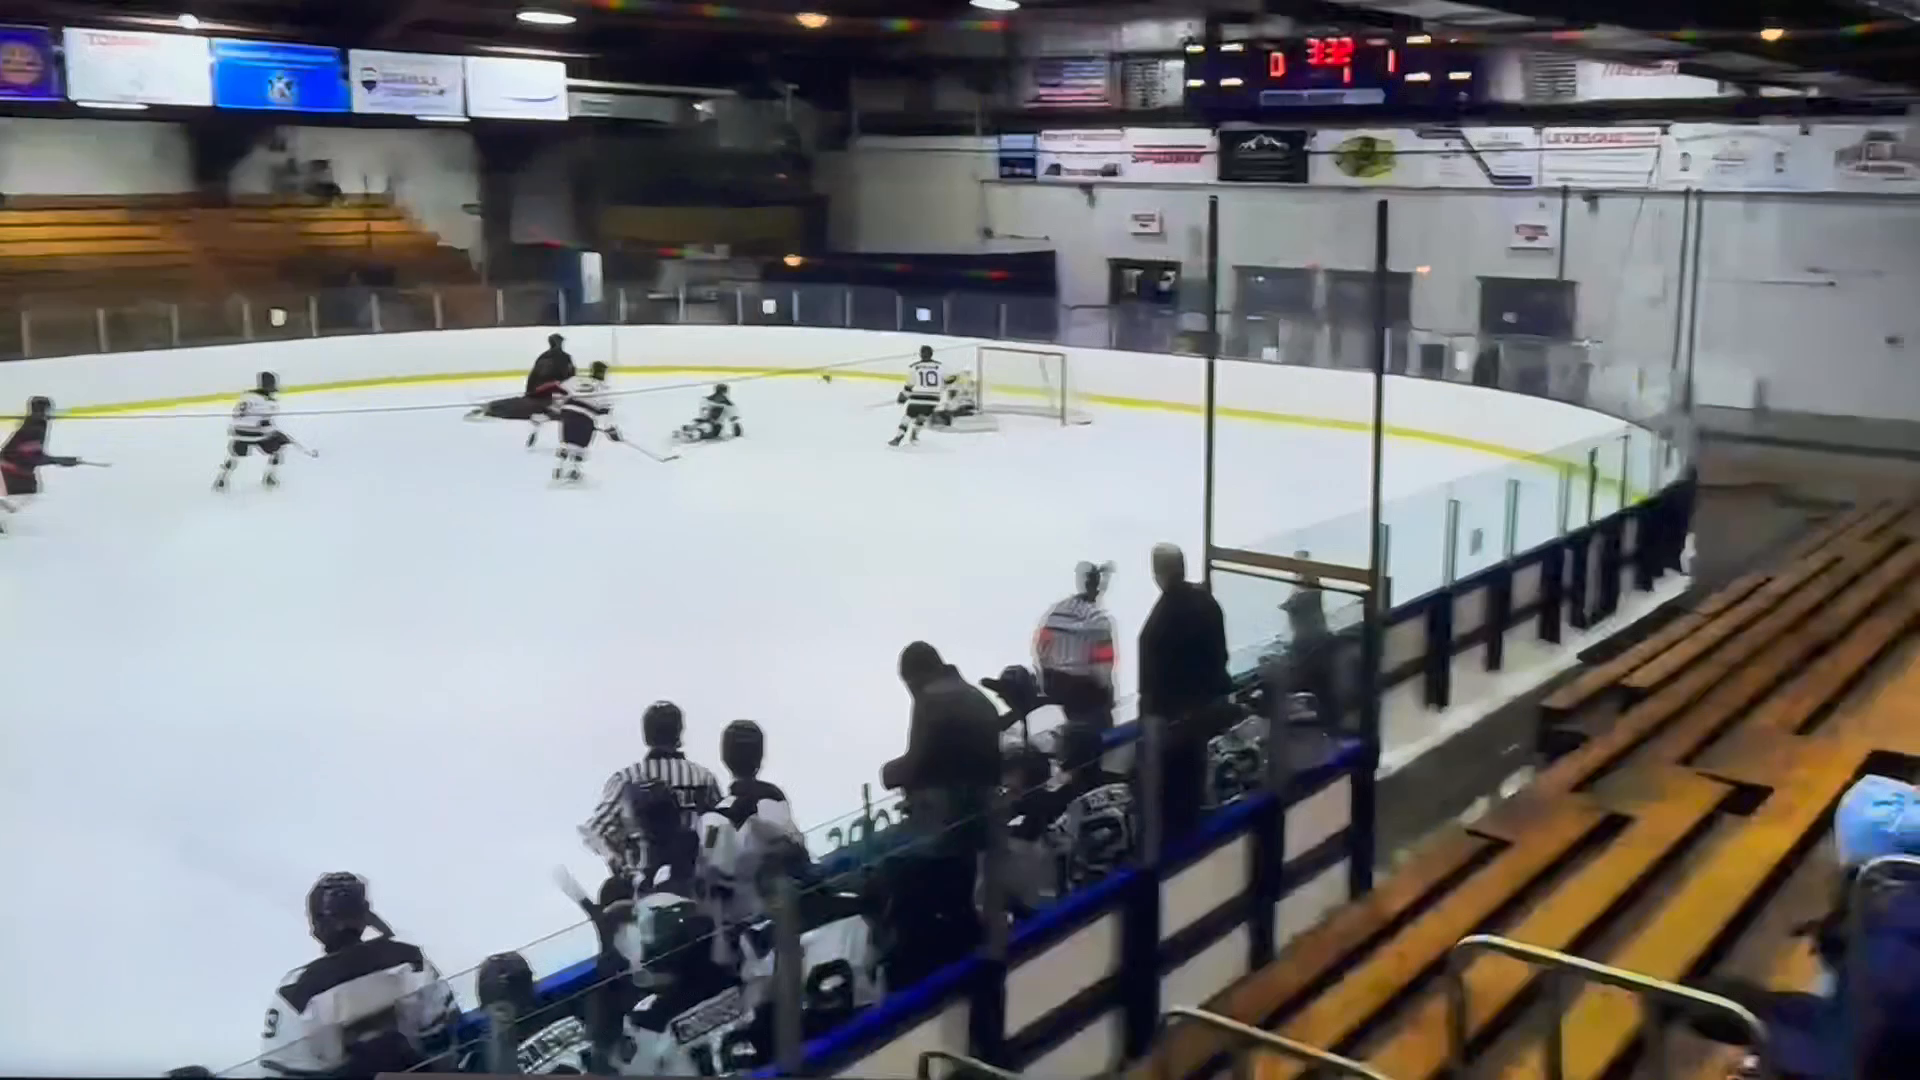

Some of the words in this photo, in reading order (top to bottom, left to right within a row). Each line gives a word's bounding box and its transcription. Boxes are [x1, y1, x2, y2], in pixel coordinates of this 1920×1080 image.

[1270, 52, 1285, 77] 0
[1387, 49, 1396, 73] 1
[918, 370, 938, 387] 10
